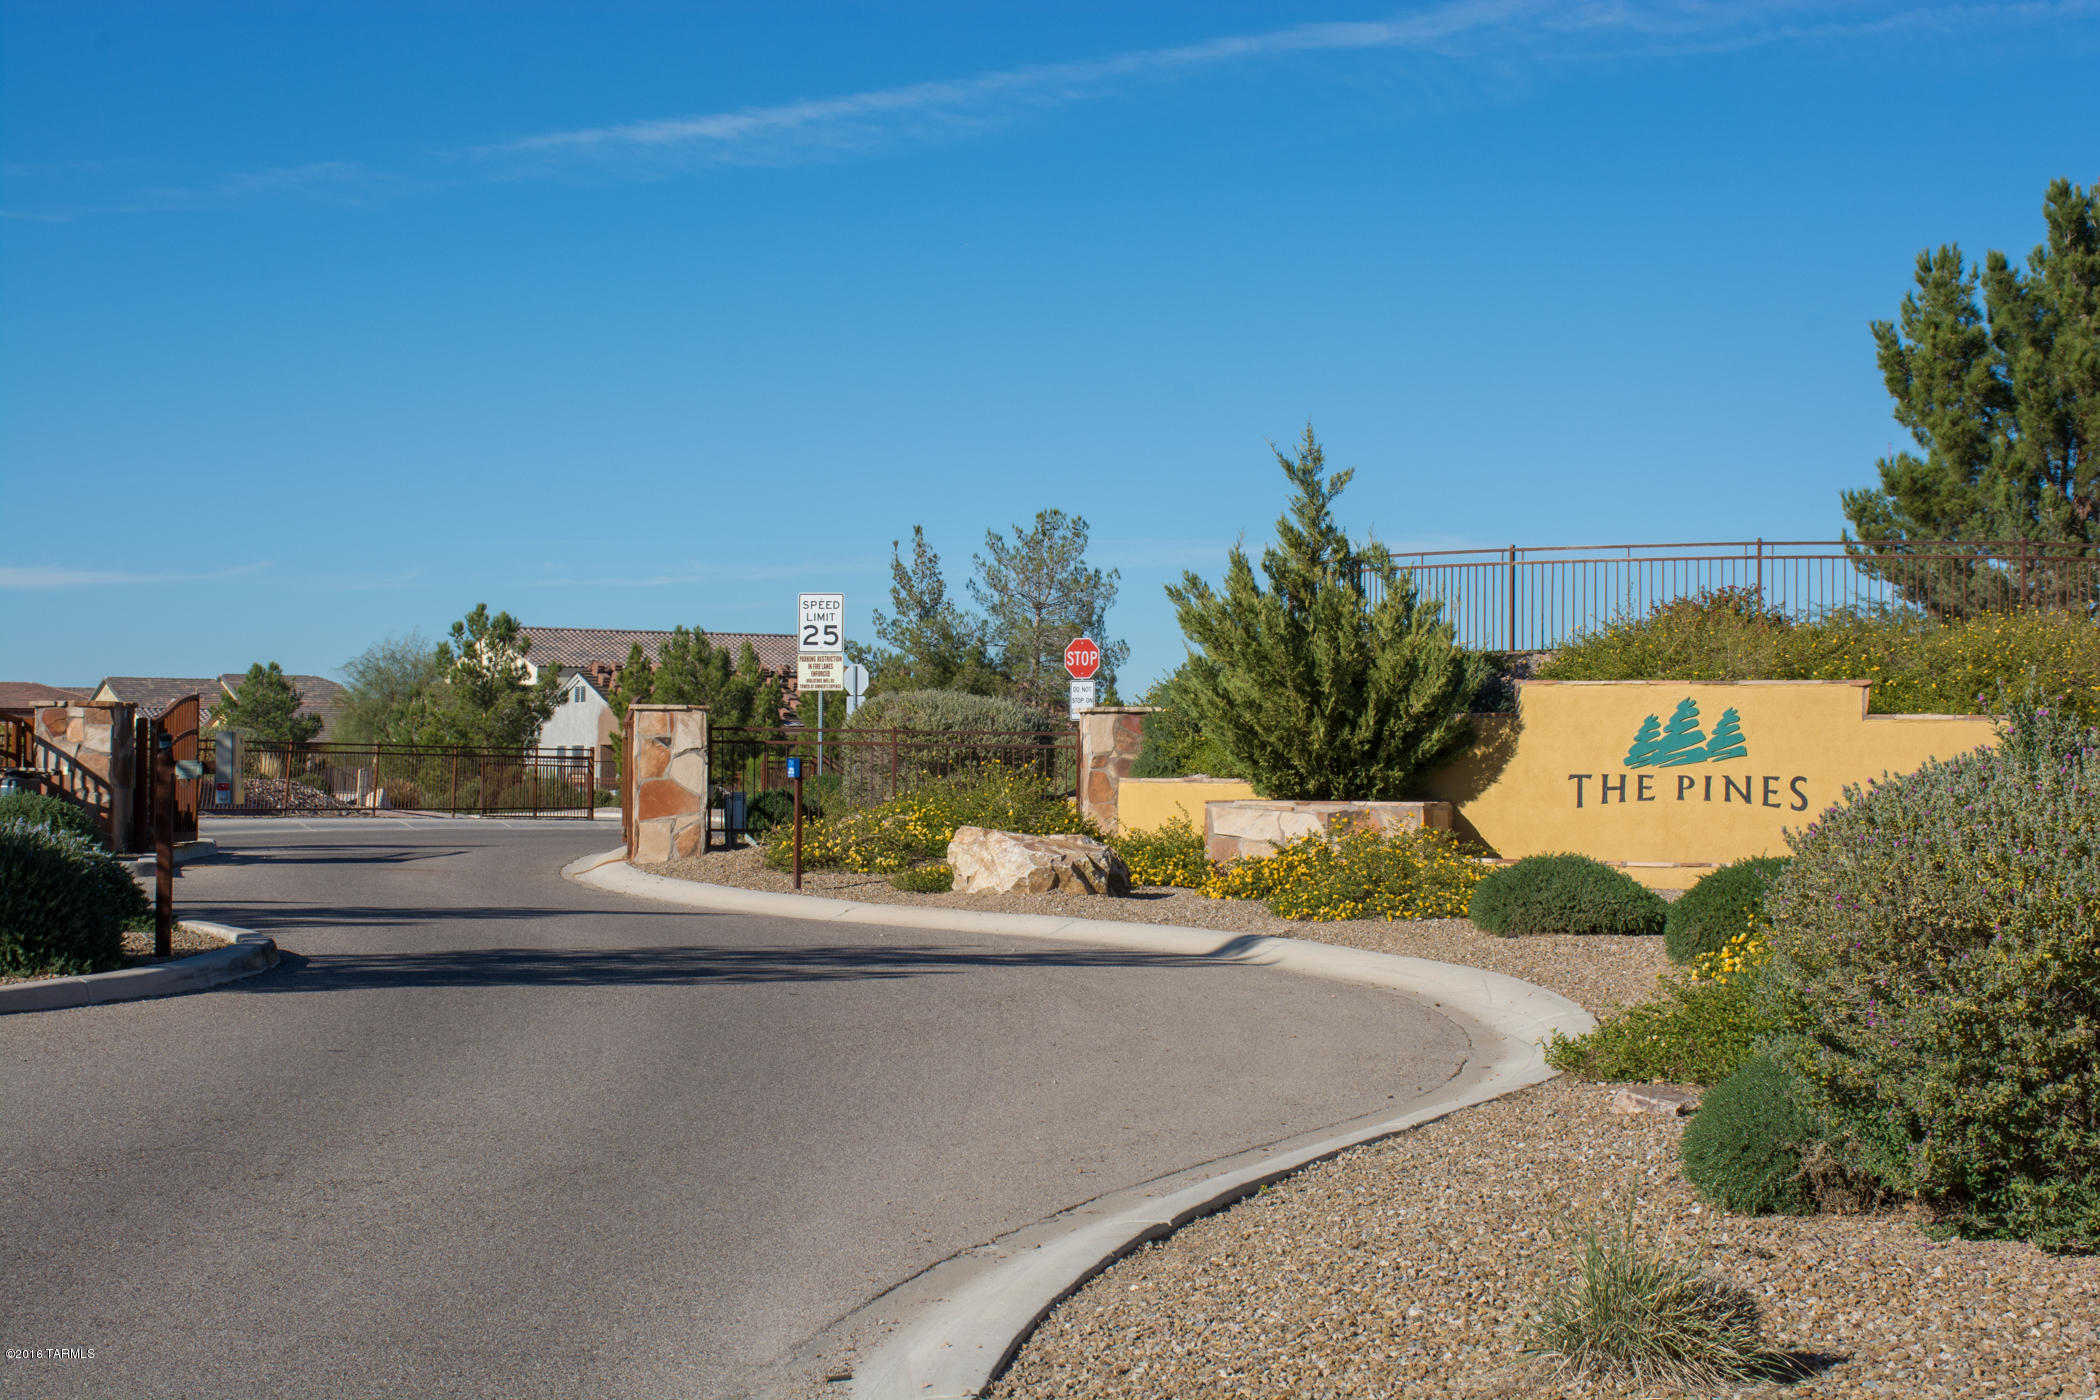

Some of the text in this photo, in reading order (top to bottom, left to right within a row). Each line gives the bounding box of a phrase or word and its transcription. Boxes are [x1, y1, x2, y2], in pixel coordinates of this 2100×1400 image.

[802, 600, 840, 610] SPEED
[806, 612, 836, 621] LIMIT
[803, 624, 839, 646] 25
[1066, 650, 1098, 666] STOP
[1568, 773, 1809, 812] THE PINES
